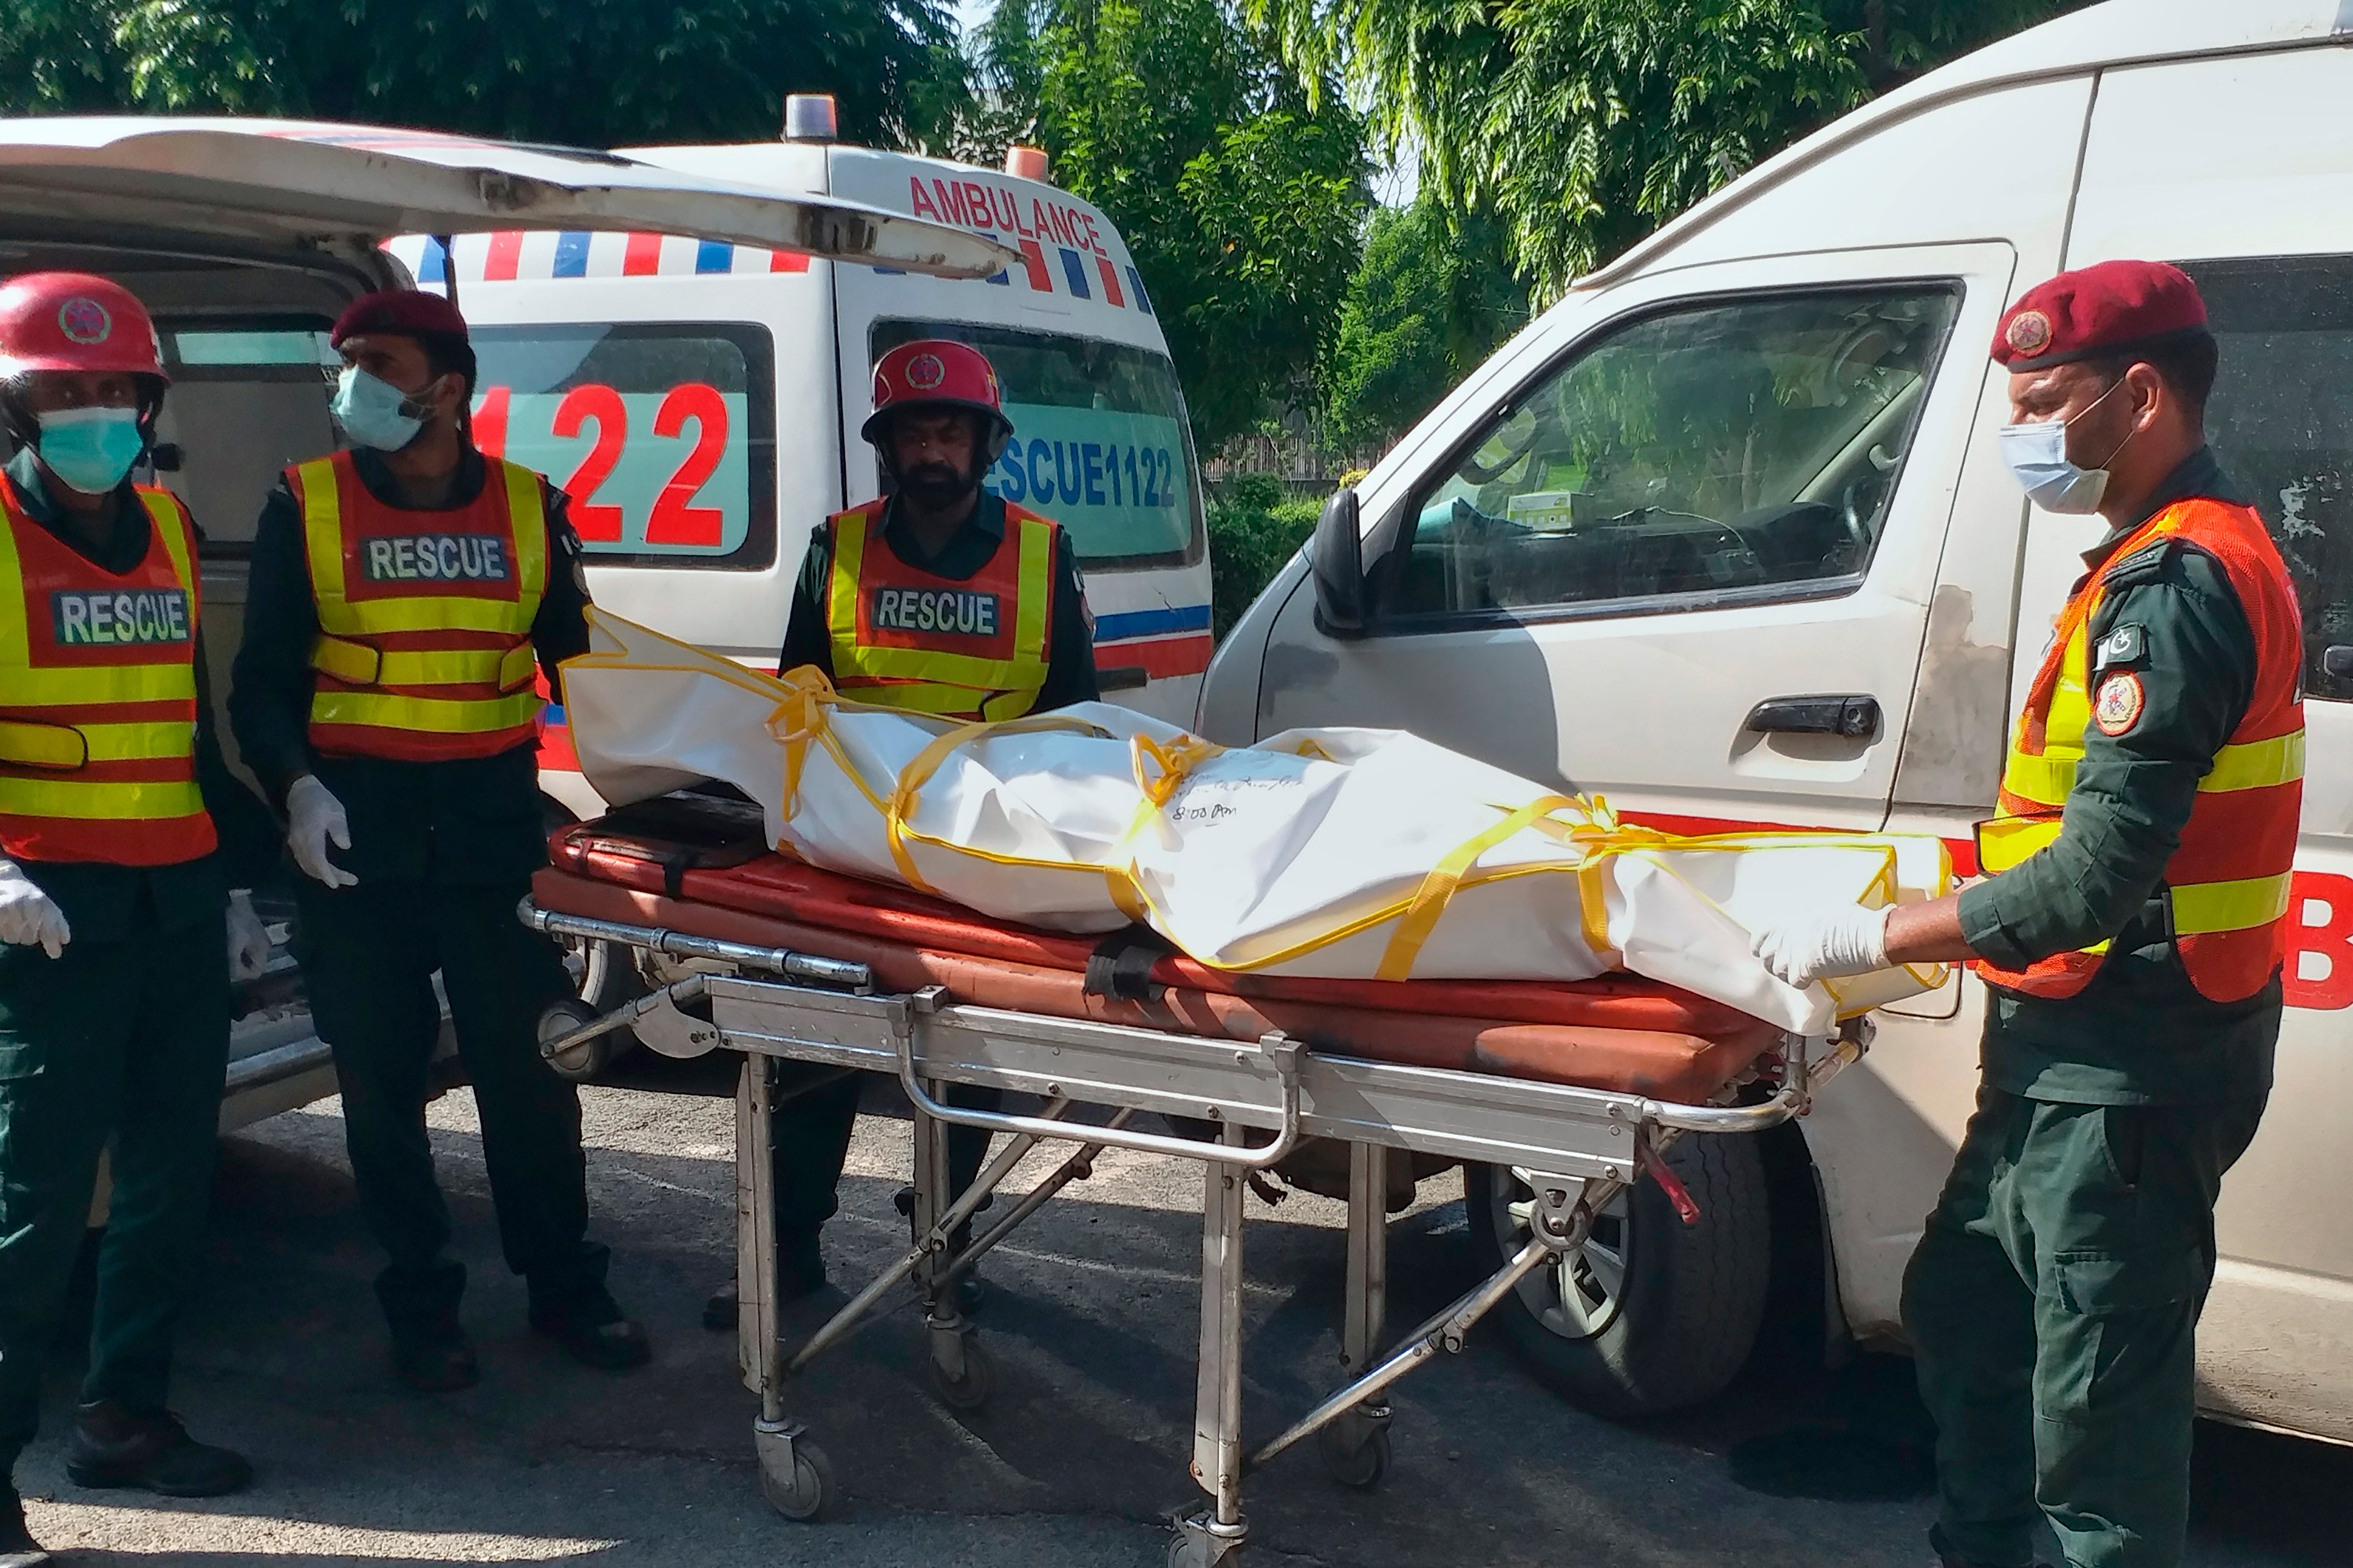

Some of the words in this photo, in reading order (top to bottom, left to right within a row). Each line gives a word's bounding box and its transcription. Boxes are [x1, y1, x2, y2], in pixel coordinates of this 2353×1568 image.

[909, 176, 1107, 257] AMBULANCE
[369, 537, 505, 579] RESCUE
[61, 593, 188, 643] RESCUE
[878, 590, 994, 634] RESCUE
